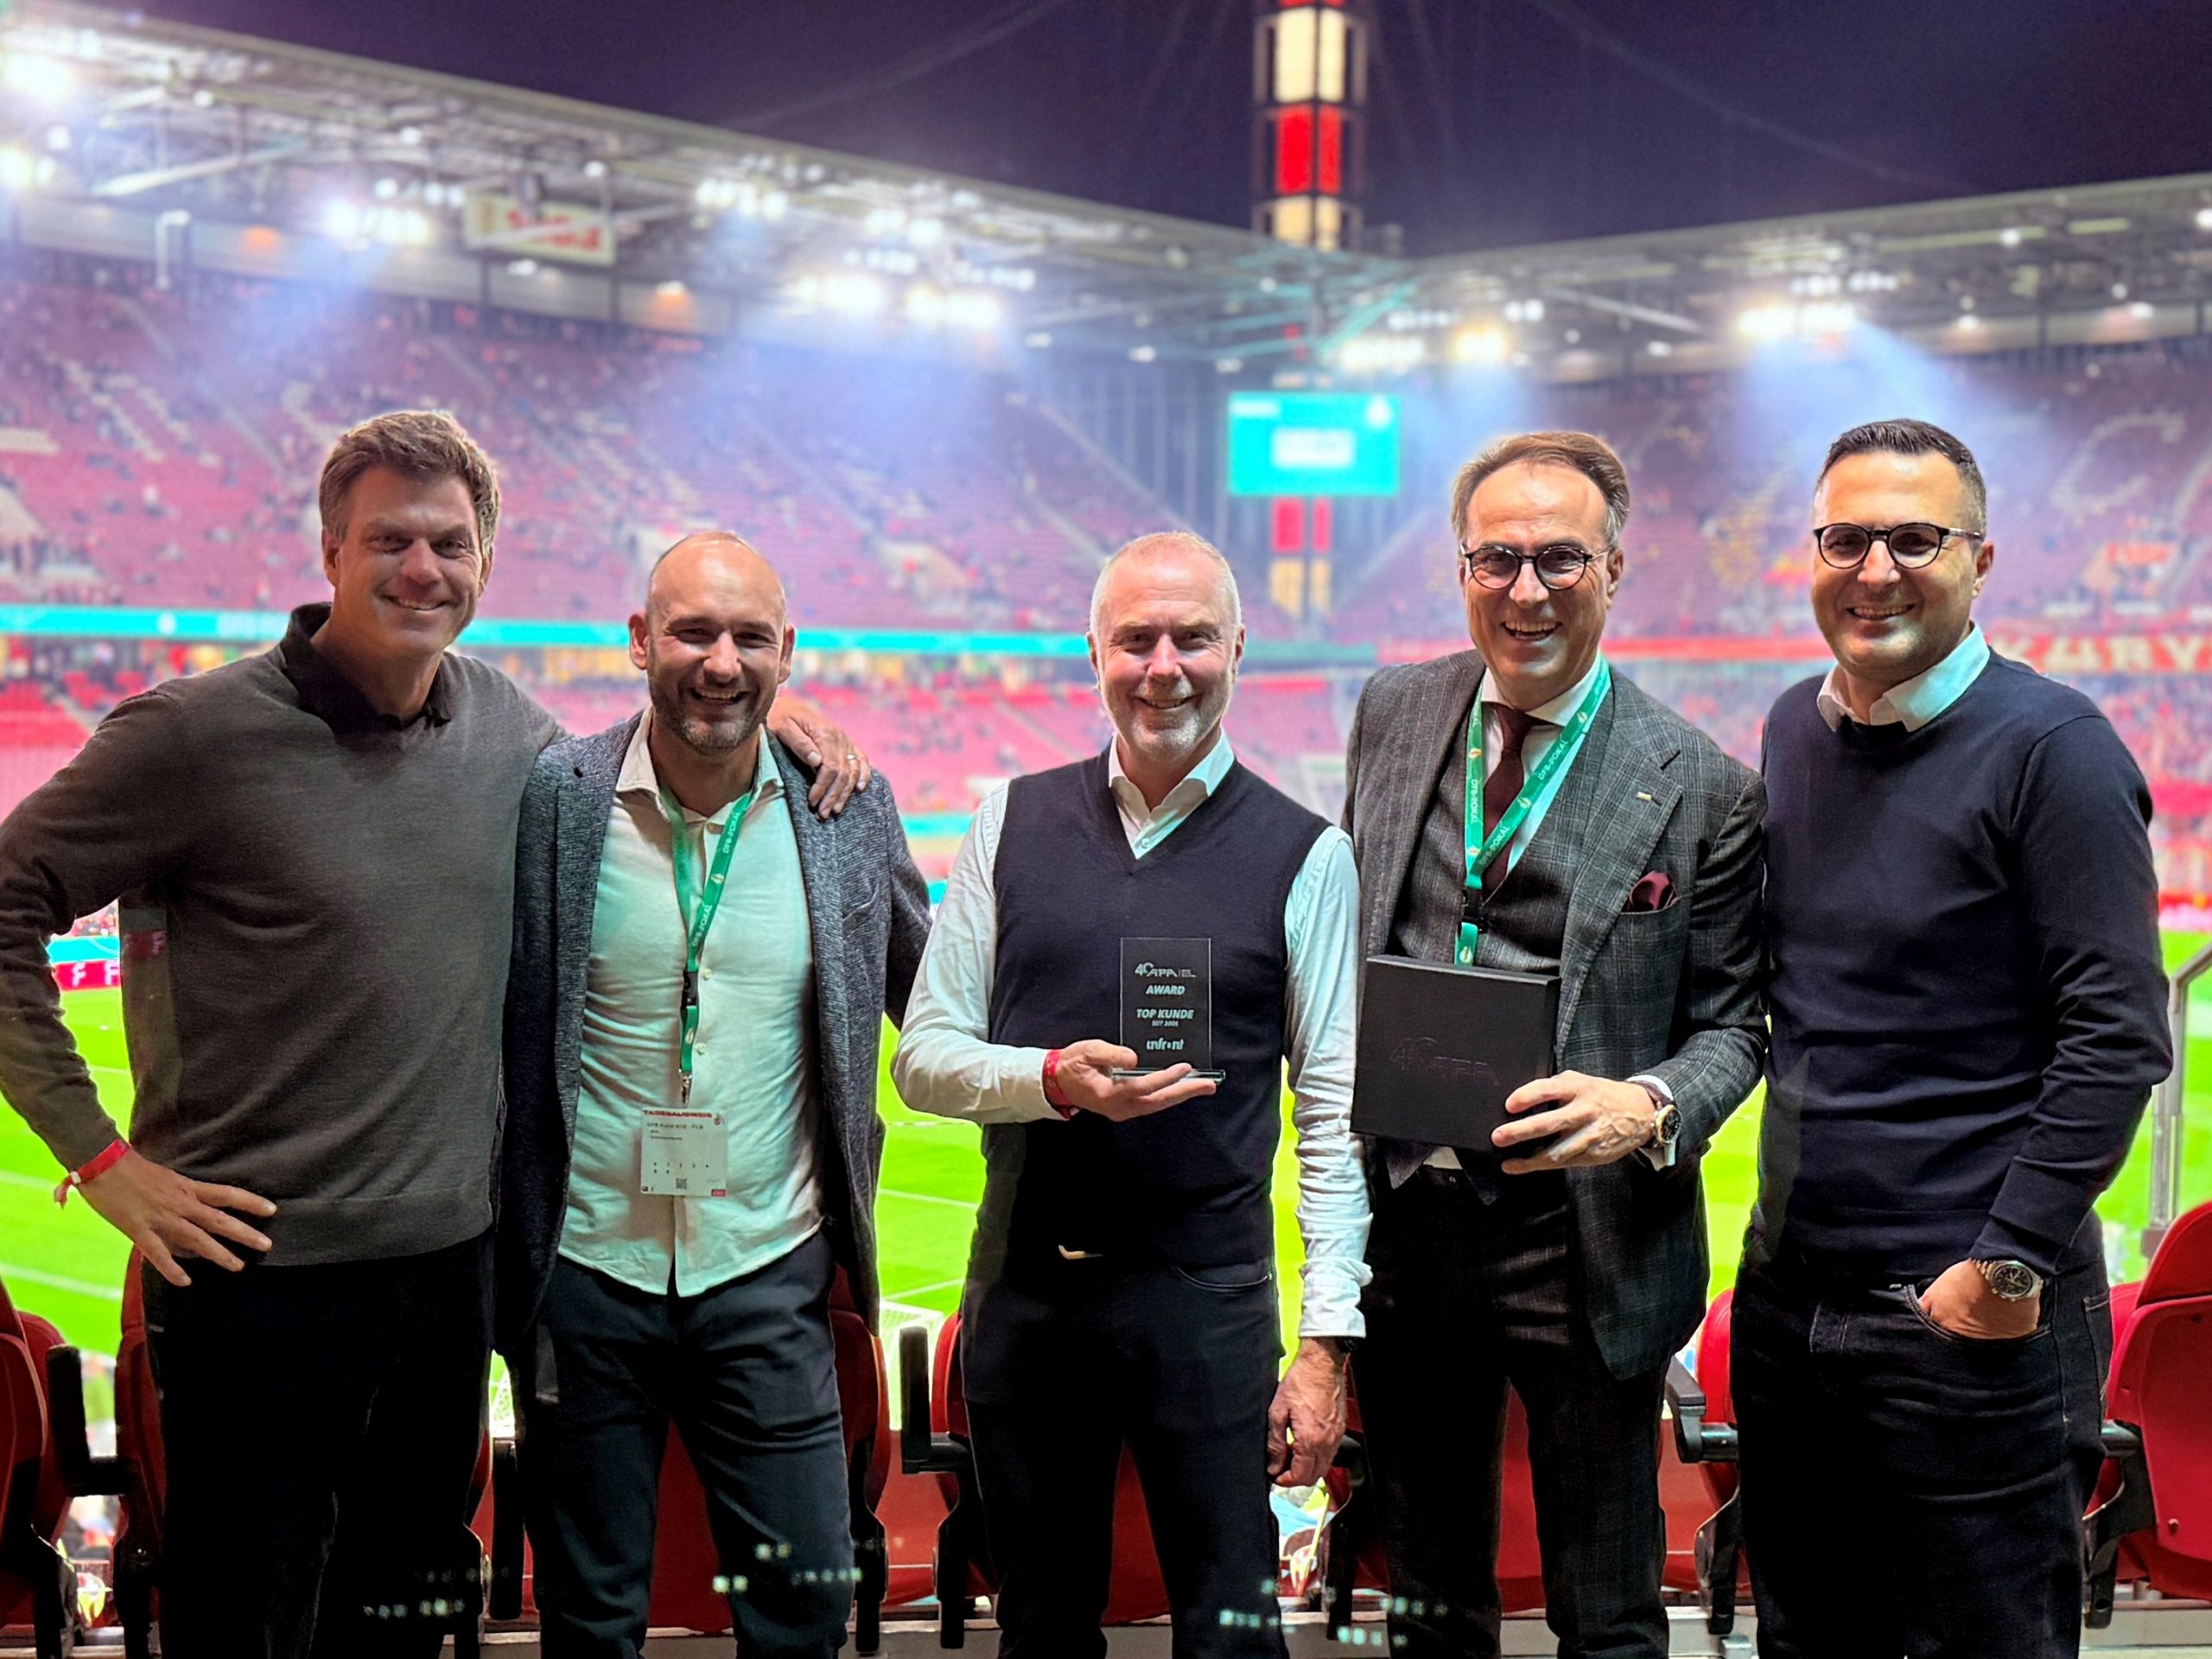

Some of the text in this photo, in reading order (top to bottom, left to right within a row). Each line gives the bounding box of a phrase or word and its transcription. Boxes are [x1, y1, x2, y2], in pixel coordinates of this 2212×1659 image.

[1538, 740, 1568, 781] DFB-POKAL
[1146, 985, 1185, 995] AWARD
[1136, 1008, 1194, 1020] TOP KUNDE
